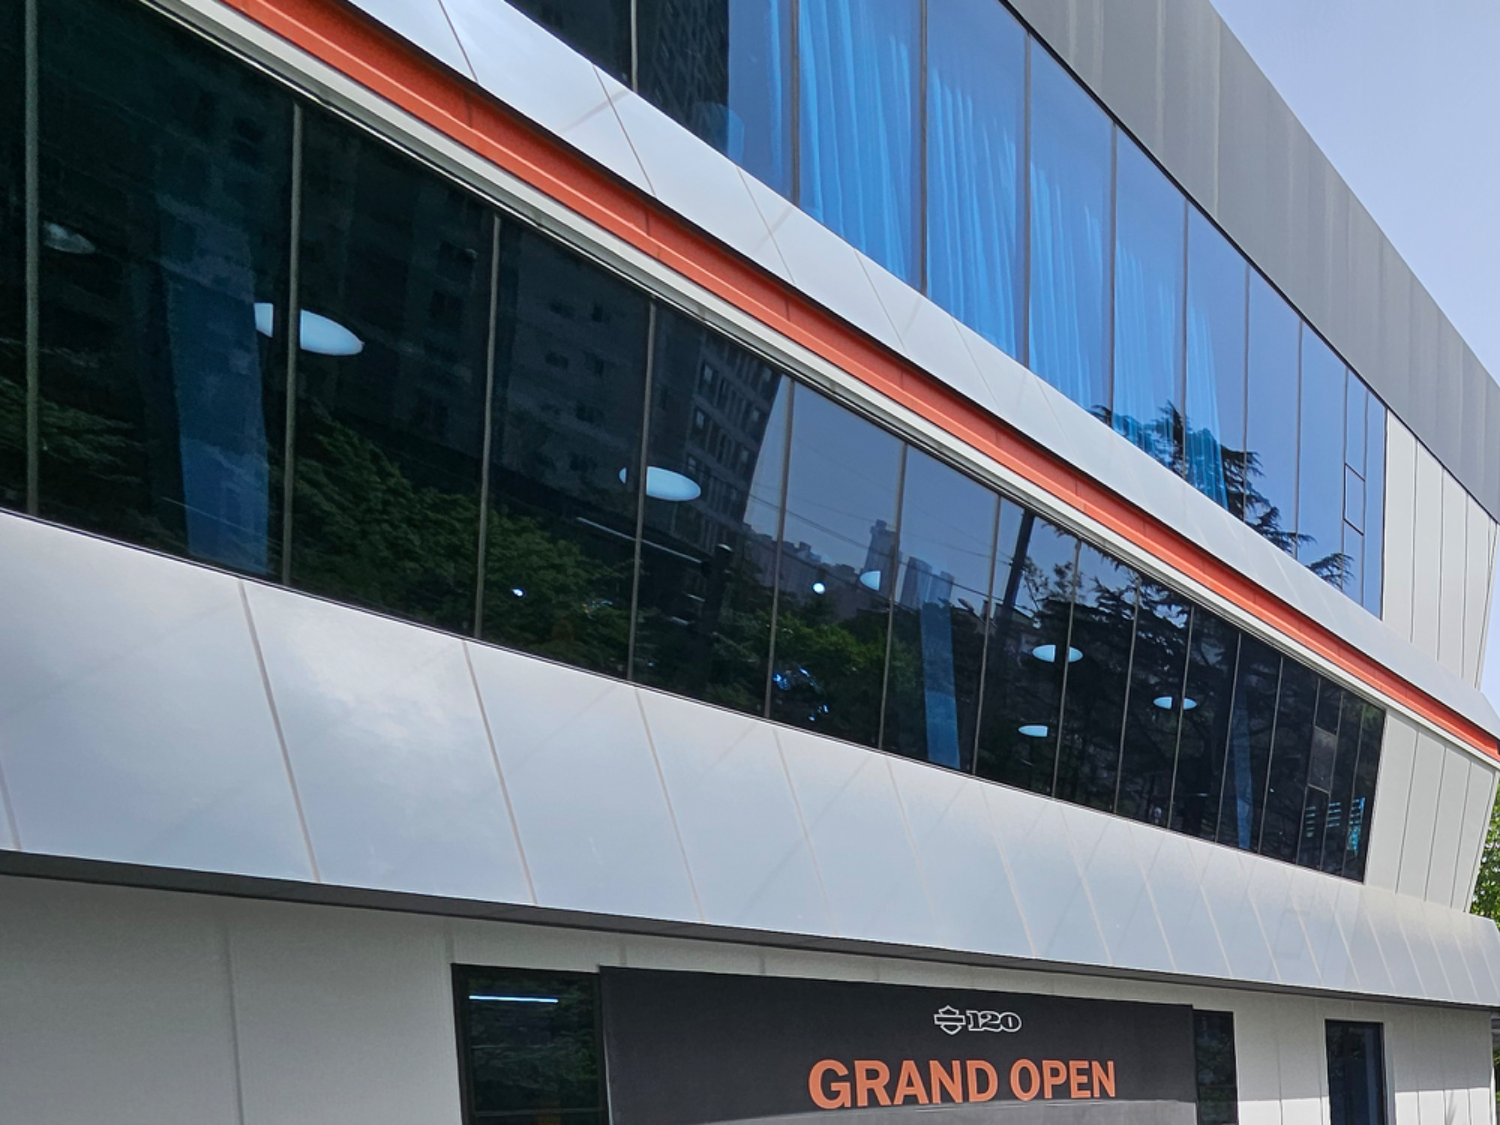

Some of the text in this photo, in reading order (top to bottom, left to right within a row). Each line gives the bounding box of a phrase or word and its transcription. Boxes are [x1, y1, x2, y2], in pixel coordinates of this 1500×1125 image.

[966, 1010, 1022, 1032] 120
[808, 1058, 1116, 1109] GRAND OPEN
